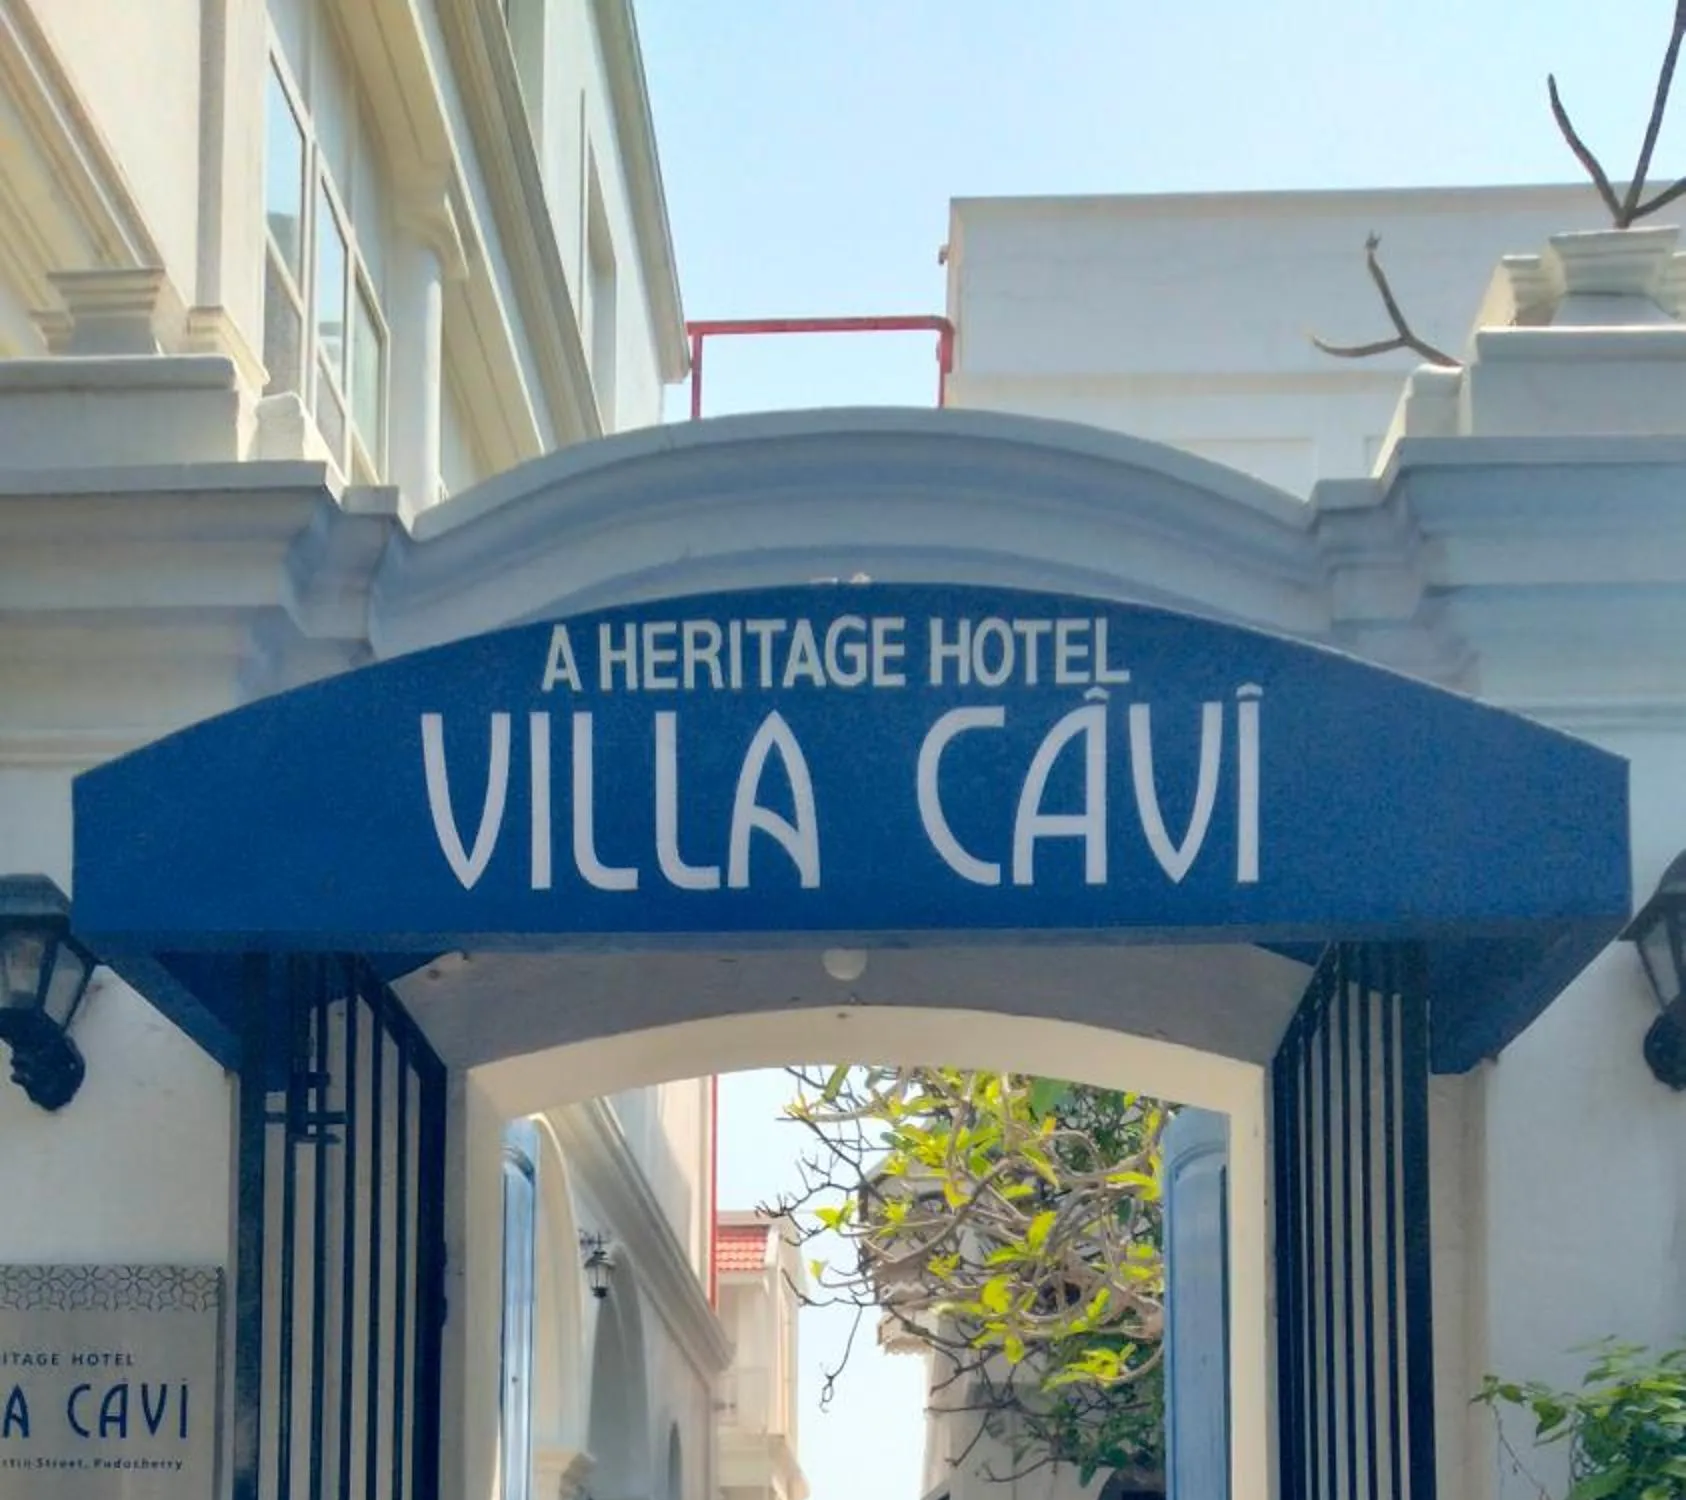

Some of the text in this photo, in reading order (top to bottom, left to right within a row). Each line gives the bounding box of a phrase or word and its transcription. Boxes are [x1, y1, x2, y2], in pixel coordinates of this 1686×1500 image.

[541, 615, 1131, 694] A HERITAGE HOTEL
[420, 708, 821, 891] VILLA
[71, 1352, 135, 1367] HOTEL
